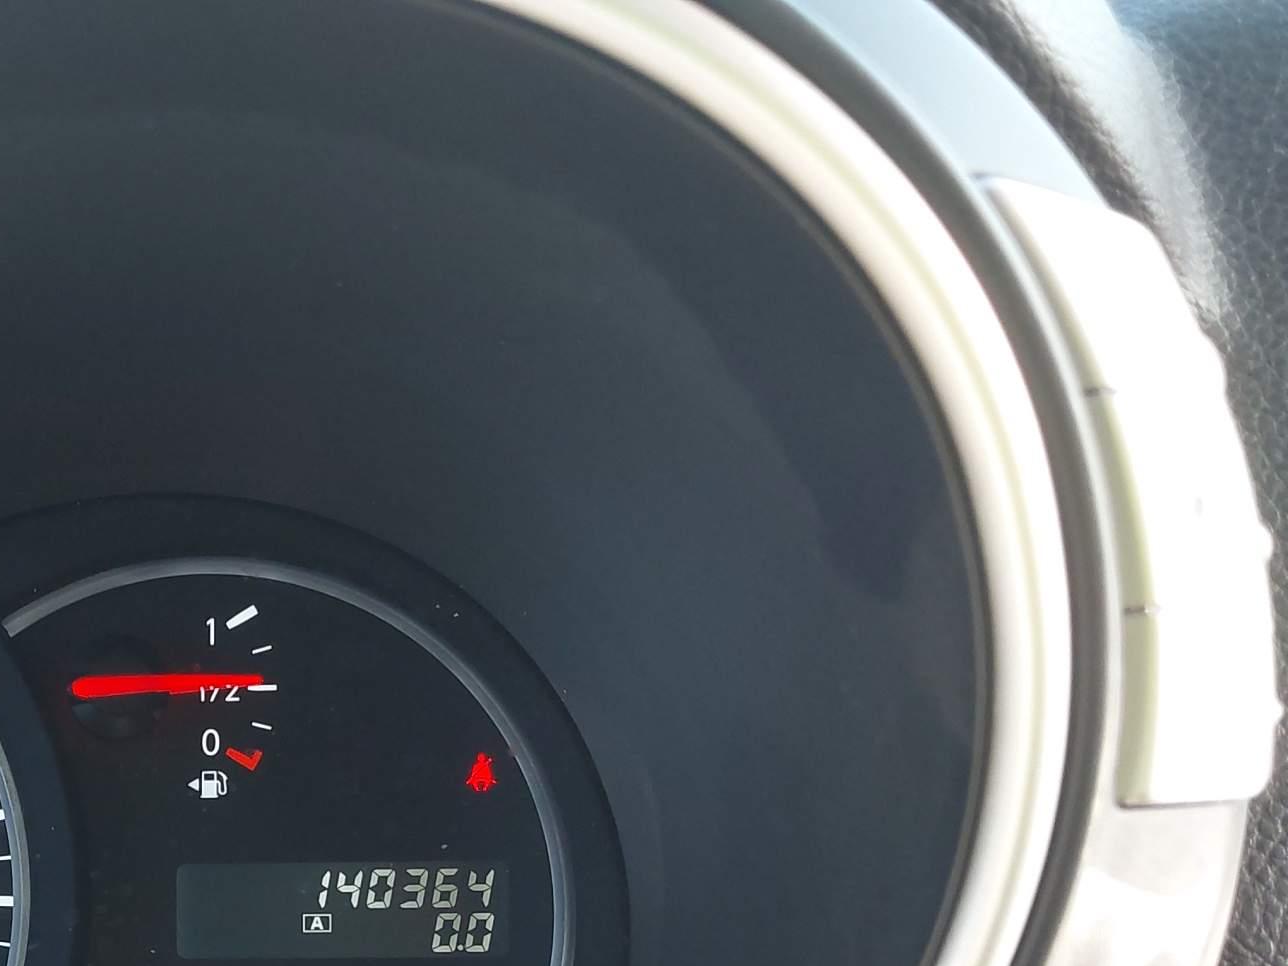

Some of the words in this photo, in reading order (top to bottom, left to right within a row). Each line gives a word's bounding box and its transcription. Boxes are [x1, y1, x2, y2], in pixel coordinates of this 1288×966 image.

[206, 617, 215, 646] 1
[201, 728, 220, 756] 0
[318, 868, 495, 909] 140364
[309, 914, 325, 932] A
[431, 912, 495, 953] 0.0
